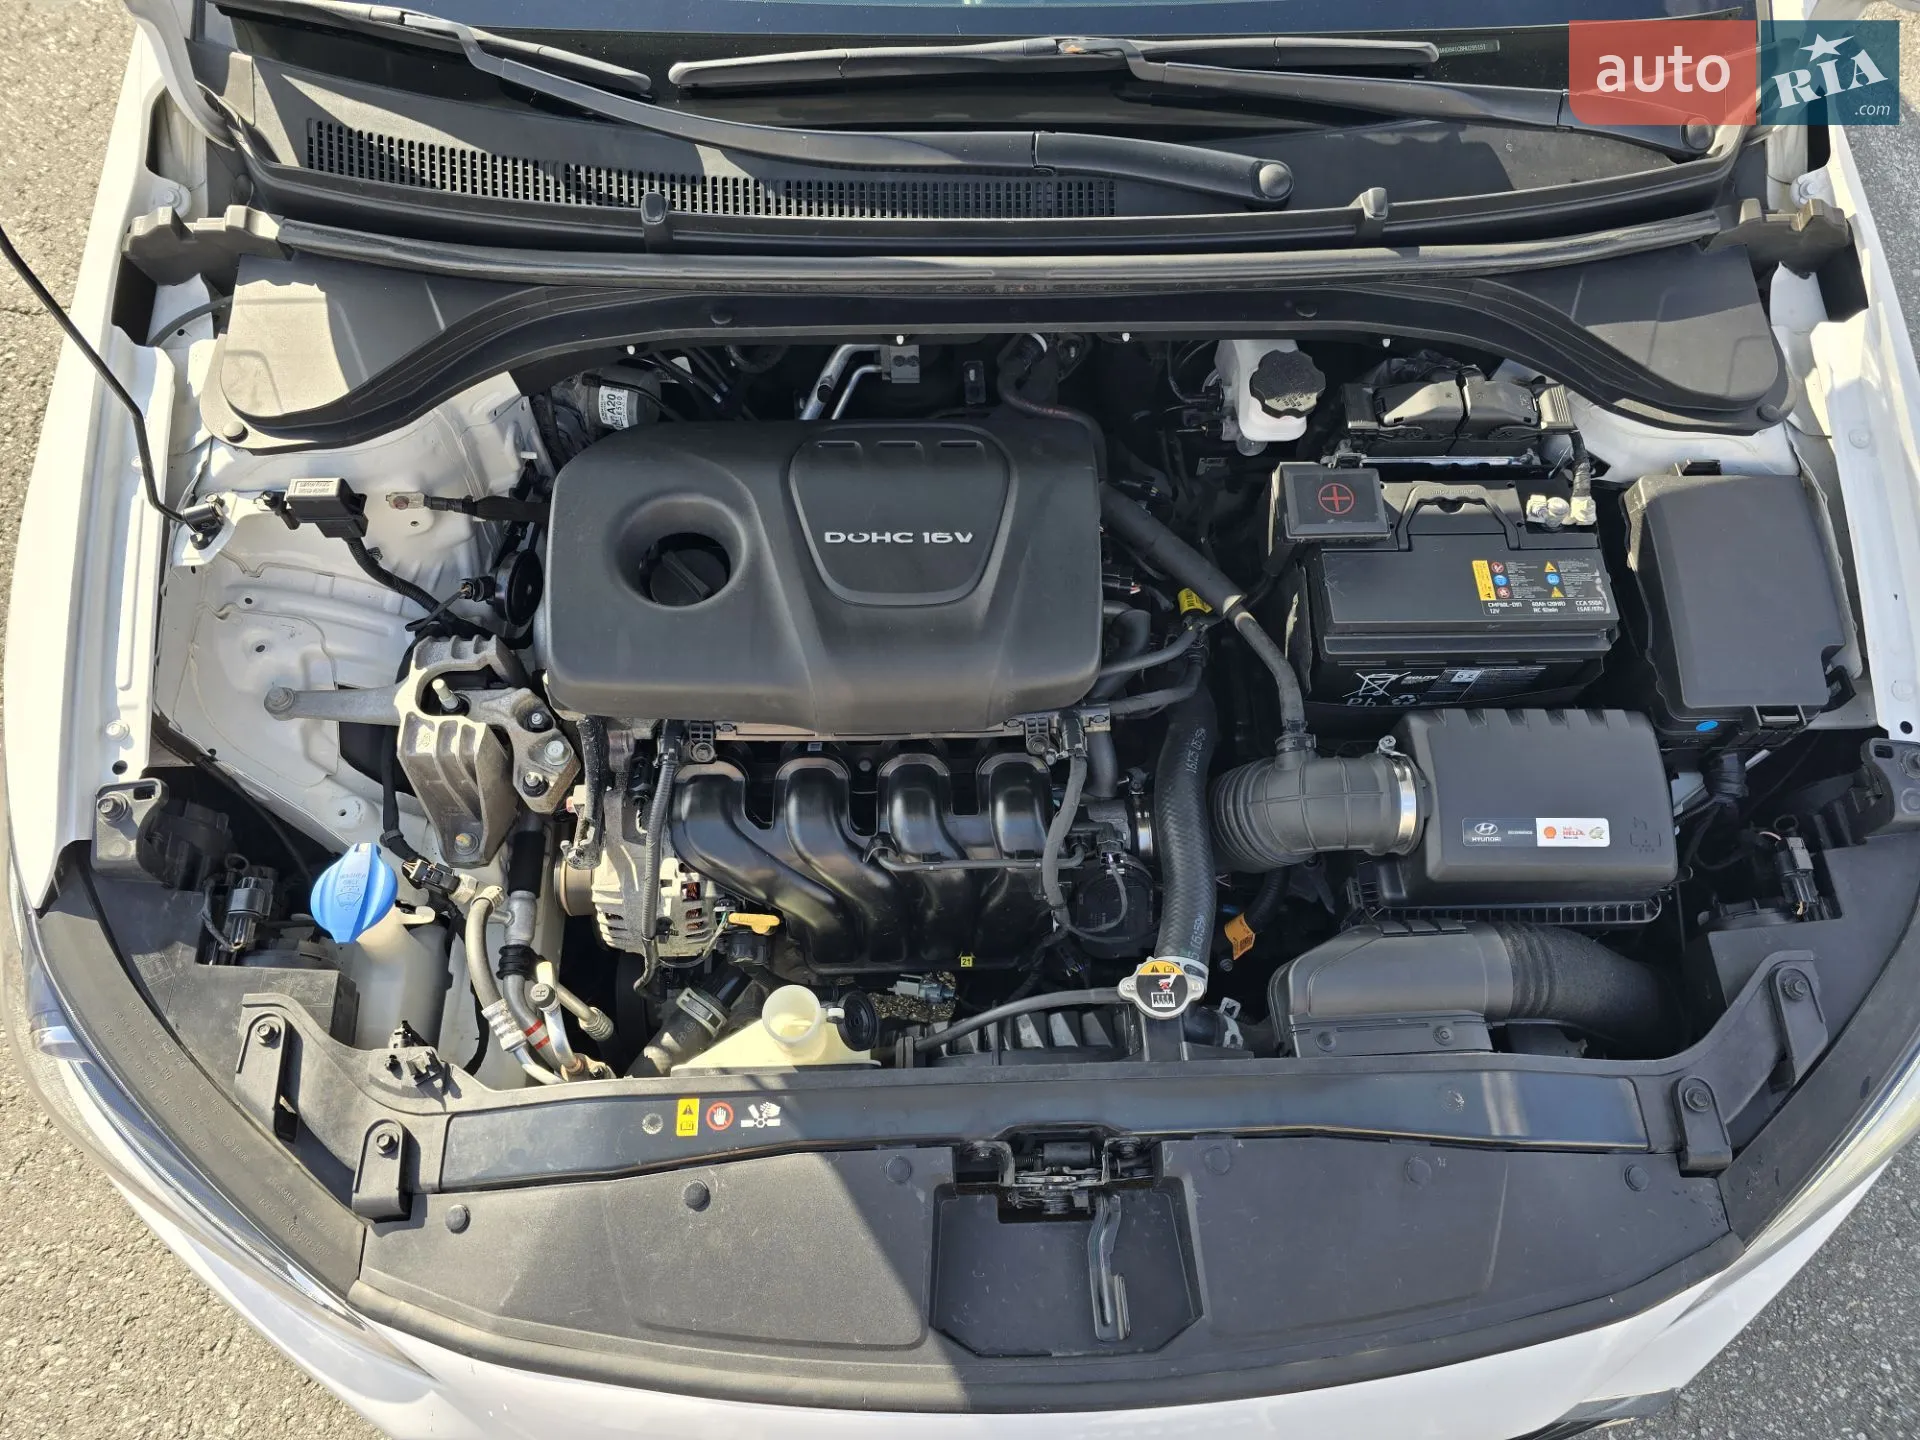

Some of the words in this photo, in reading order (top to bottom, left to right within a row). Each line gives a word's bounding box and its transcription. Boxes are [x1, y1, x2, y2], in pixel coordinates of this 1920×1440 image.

[606, 393, 617, 416] A20
[824, 531, 914, 544] DOHC
[922, 531, 973, 544] 16V
